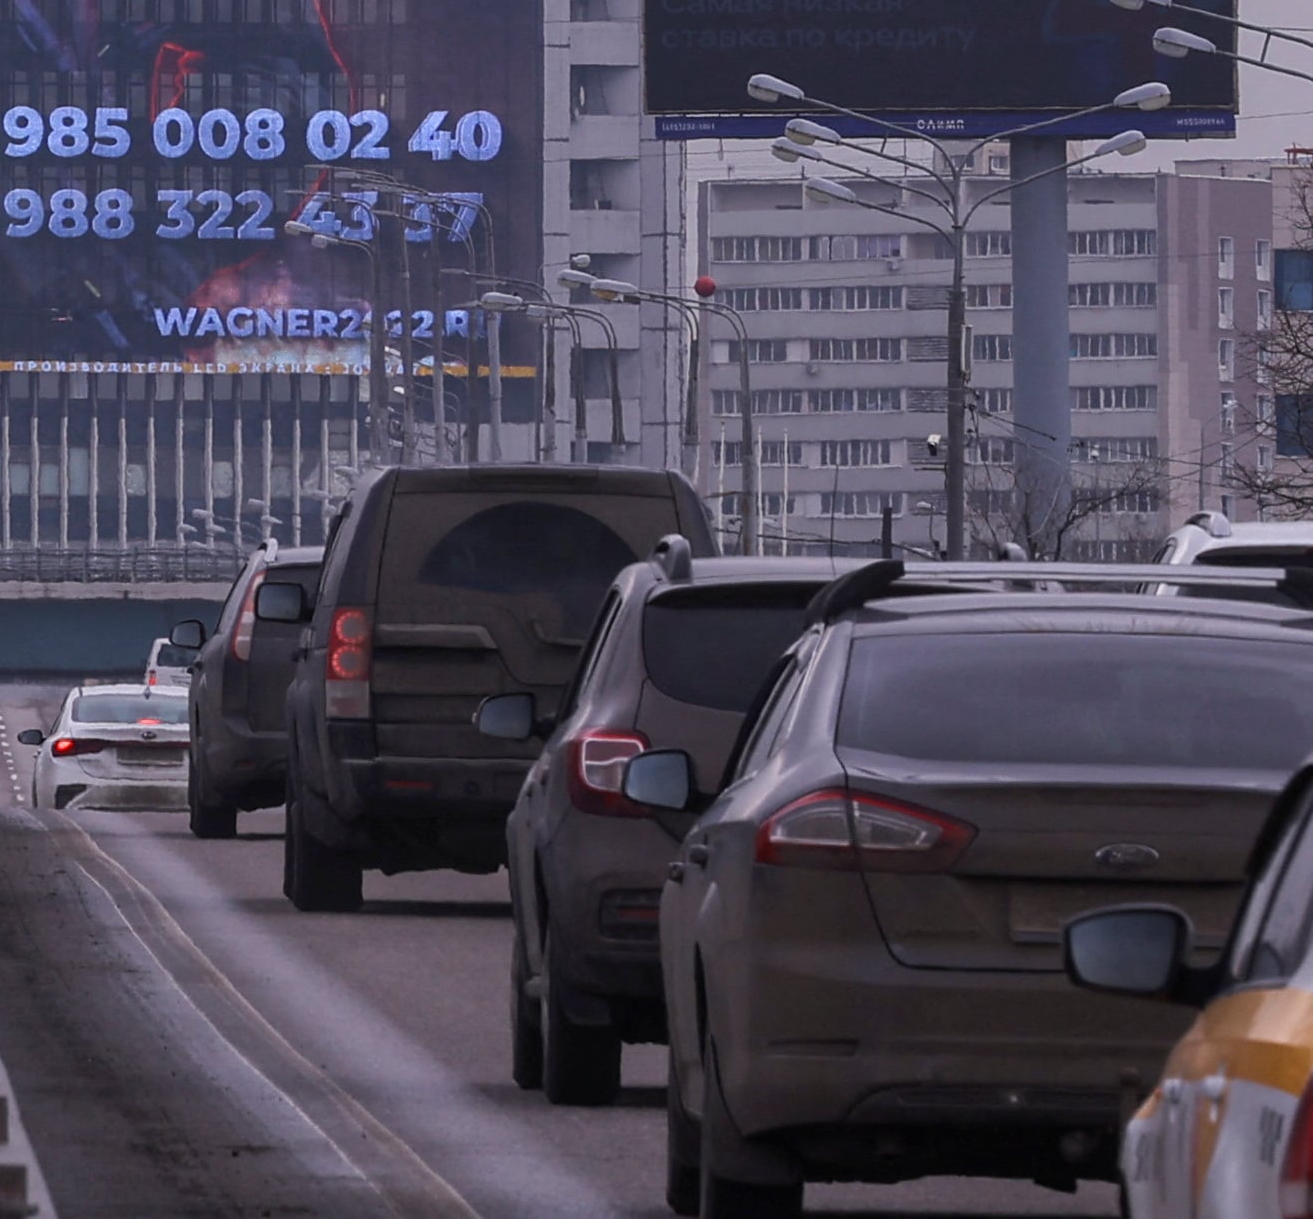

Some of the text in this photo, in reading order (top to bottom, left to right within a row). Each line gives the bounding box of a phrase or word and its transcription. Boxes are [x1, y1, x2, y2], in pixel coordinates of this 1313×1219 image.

[661, 25, 976, 53] ставка по кредиту
[3, 105, 131, 158] 985
[153, 106, 286, 160] 008
[306, 109, 390, 160] 02
[407, 110, 503, 161] 40
[4, 187, 134, 239] 988
[155, 188, 275, 240] 322
[296, 191, 378, 241] 43
[403, 192, 483, 242] 37
[14, 360, 183, 373] ПРОИЗВОДИТЕЛЬ
